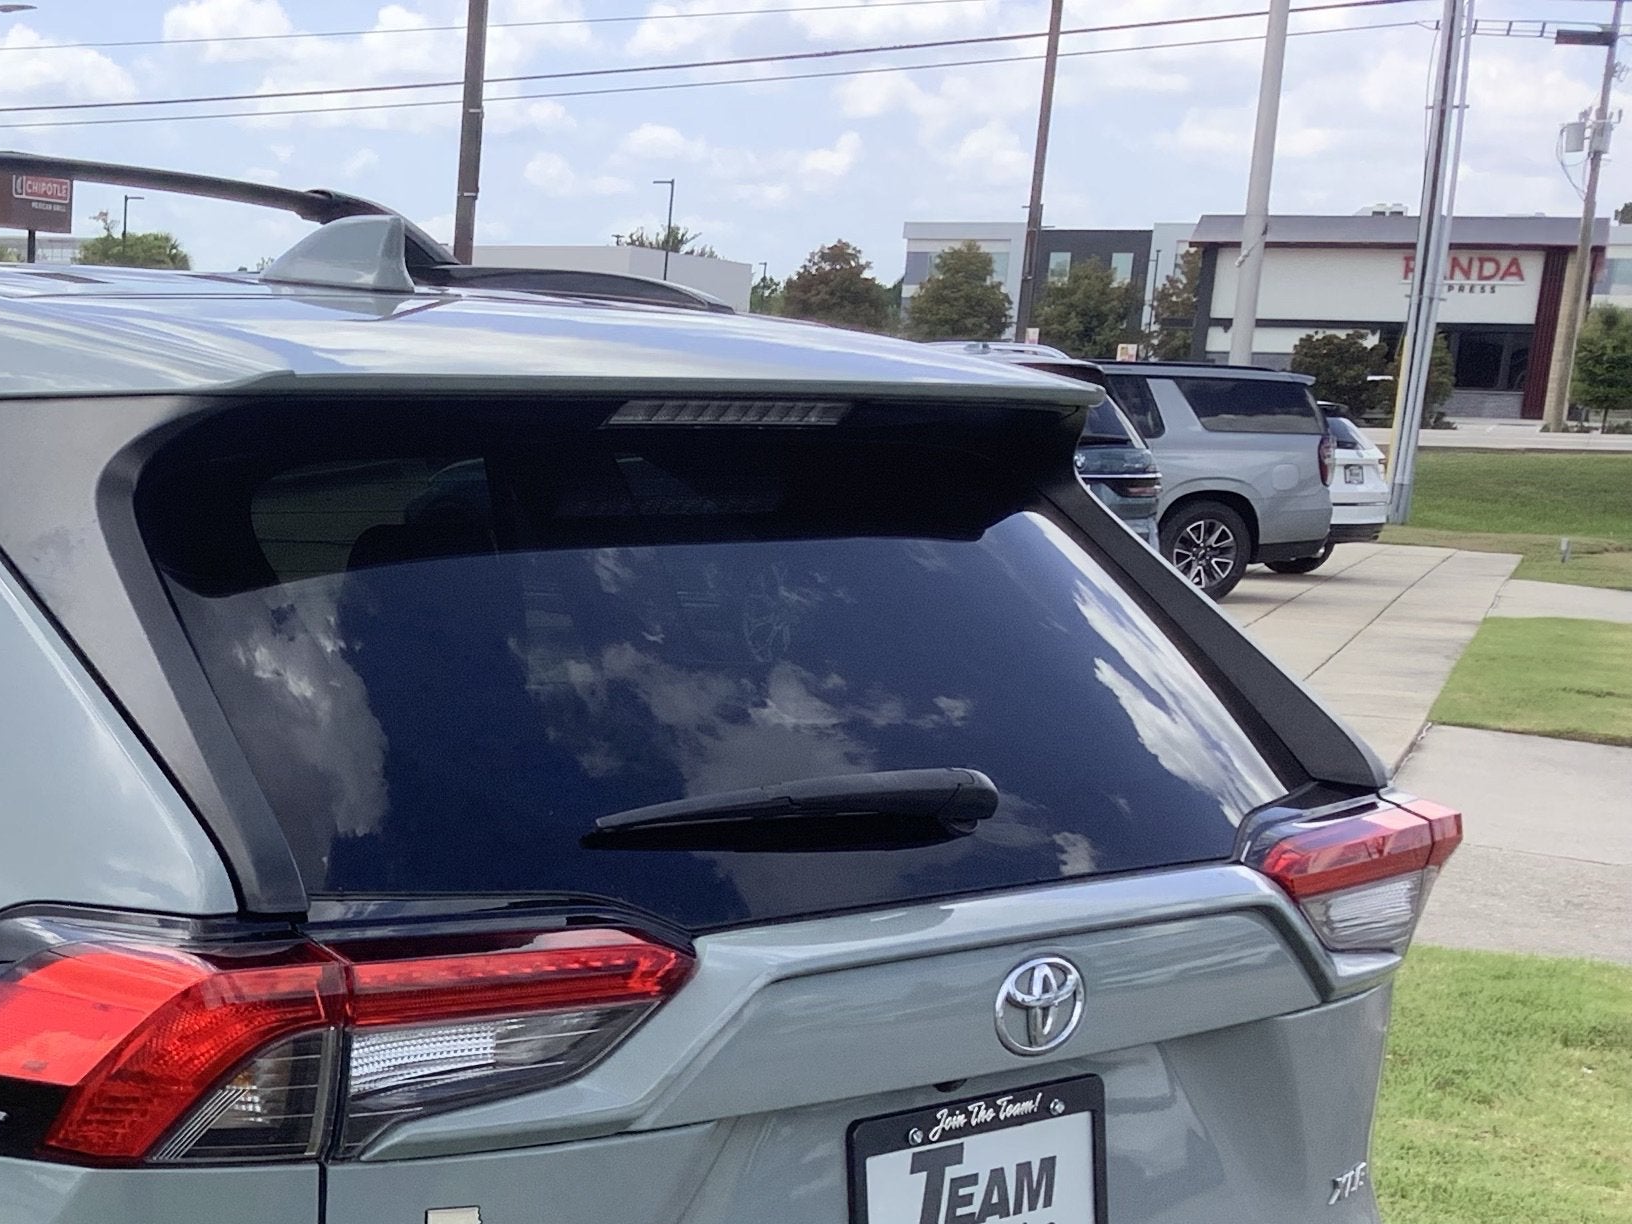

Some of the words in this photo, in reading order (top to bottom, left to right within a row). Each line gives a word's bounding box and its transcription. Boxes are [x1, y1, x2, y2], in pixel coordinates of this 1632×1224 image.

[26, 180, 67, 197] CHIPOTLE
[1403, 255, 1525, 281] PNDA
[929, 1108, 966, 1142] Join
[968, 1101, 996, 1127] The
[997, 1092, 1042, 1121] Team!
